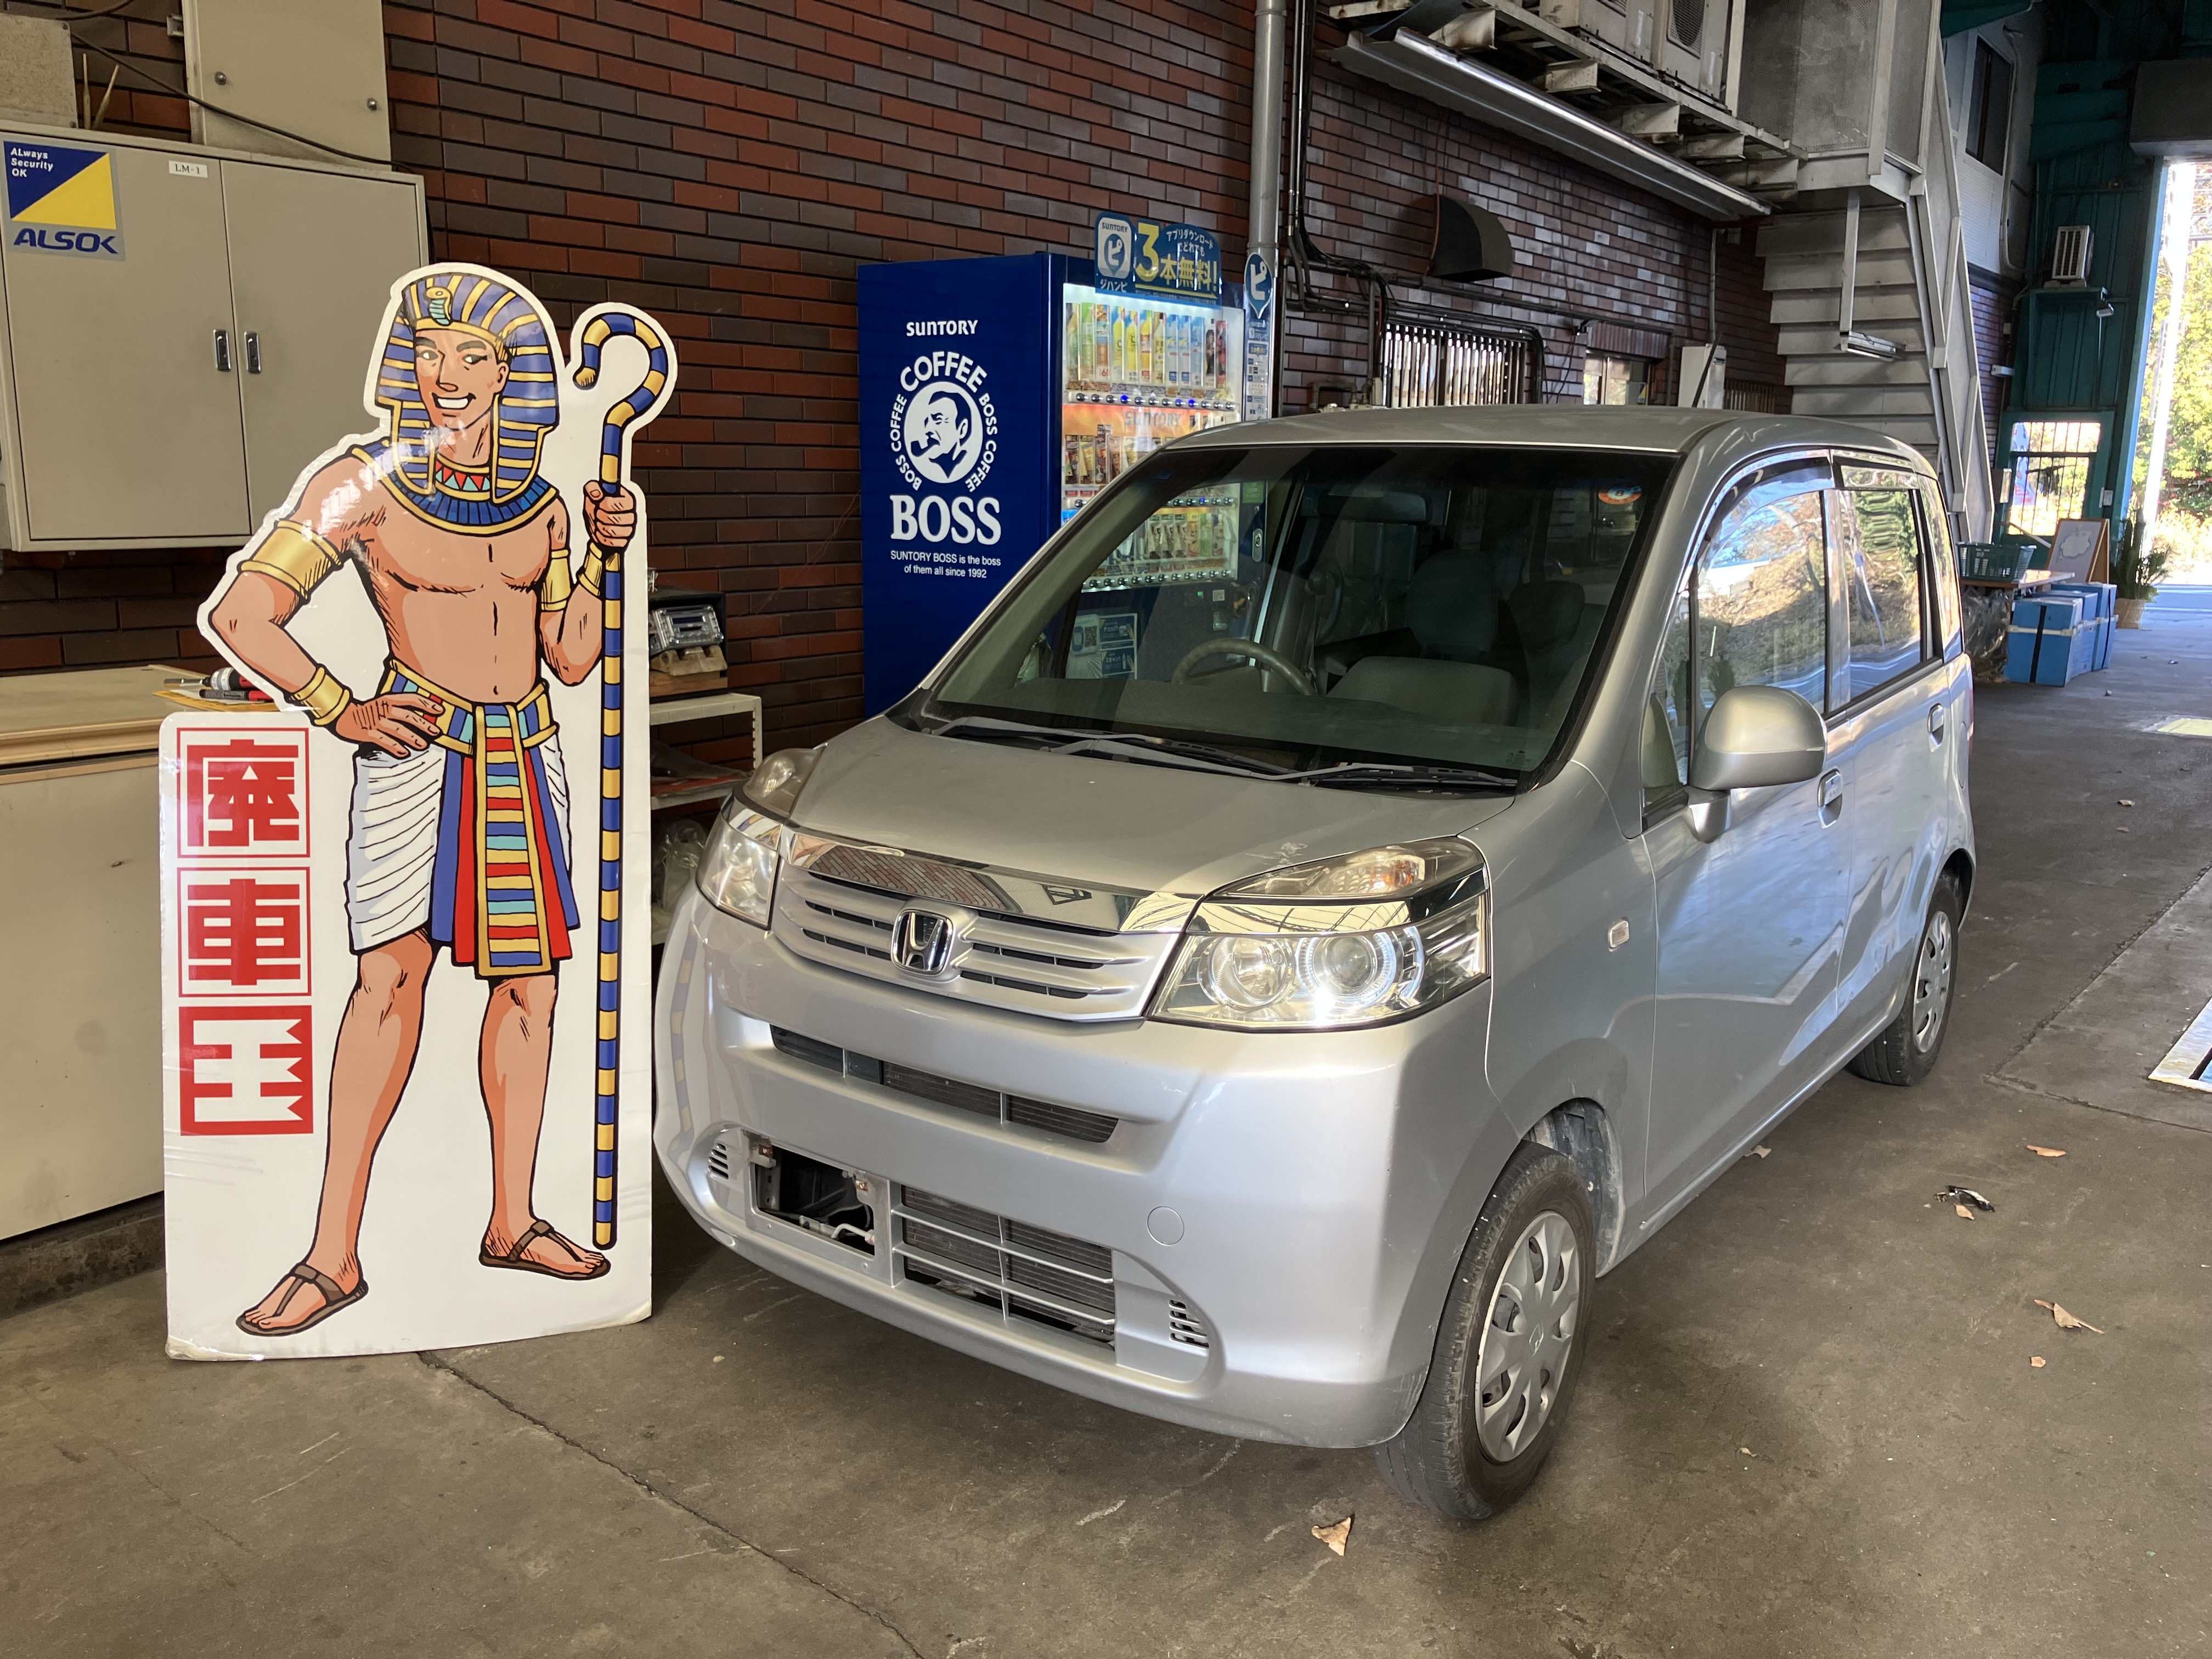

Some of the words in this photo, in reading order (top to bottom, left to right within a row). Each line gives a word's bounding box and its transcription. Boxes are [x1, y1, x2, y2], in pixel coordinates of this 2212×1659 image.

[10, 147, 48, 160] ALways
[11, 157, 54, 172] Security
[12, 168, 27, 177] OK
[1102, 222, 1128, 233] SUNTORY
[14, 228, 119, 255] ALSOK
[1250, 261, 1267, 301] ピ
[906, 320, 978, 336] SUNTORY
[900, 351, 987, 393] COFFEE
[890, 393, 907, 452] COFFEE
[979, 393, 998, 436] BOSS
[1125, 411, 1181, 427] SUNTORY
[895, 454, 922, 491] BOSS
[965, 440, 997, 492] COFFEE
[890, 495, 1001, 545] BOSS
[890, 550, 931, 562] SUNTORY
[933, 553, 957, 563] BOSS
[959, 555, 966, 564] is
[967, 555, 980, 565] the
[982, 556, 1001, 566] boss
[904, 564, 912, 573] of
[913, 565, 932, 574] them
[934, 566, 944, 575] all
[945, 567, 966, 577] since
[968, 568, 987, 578] 1992
[187, 738, 303, 1123] 廃車王
